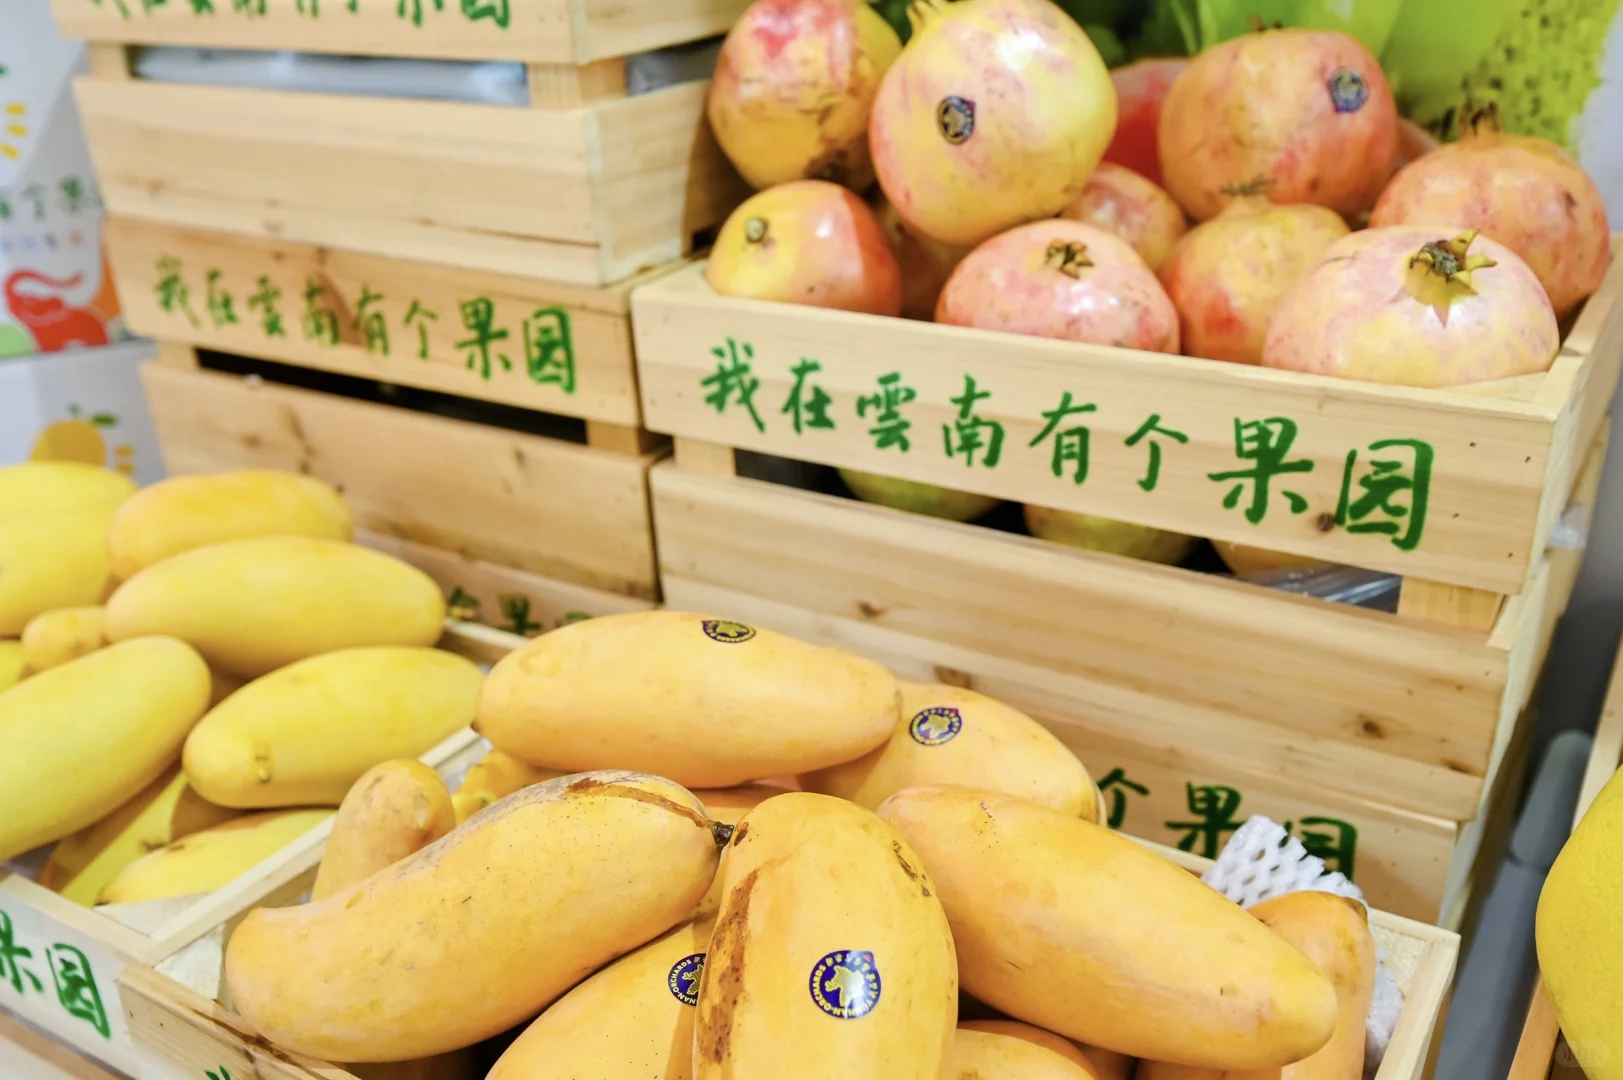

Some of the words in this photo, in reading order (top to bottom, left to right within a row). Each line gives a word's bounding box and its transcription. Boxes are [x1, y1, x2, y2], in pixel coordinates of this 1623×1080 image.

[700, 337, 1435, 552] 我在雲南有个果园
